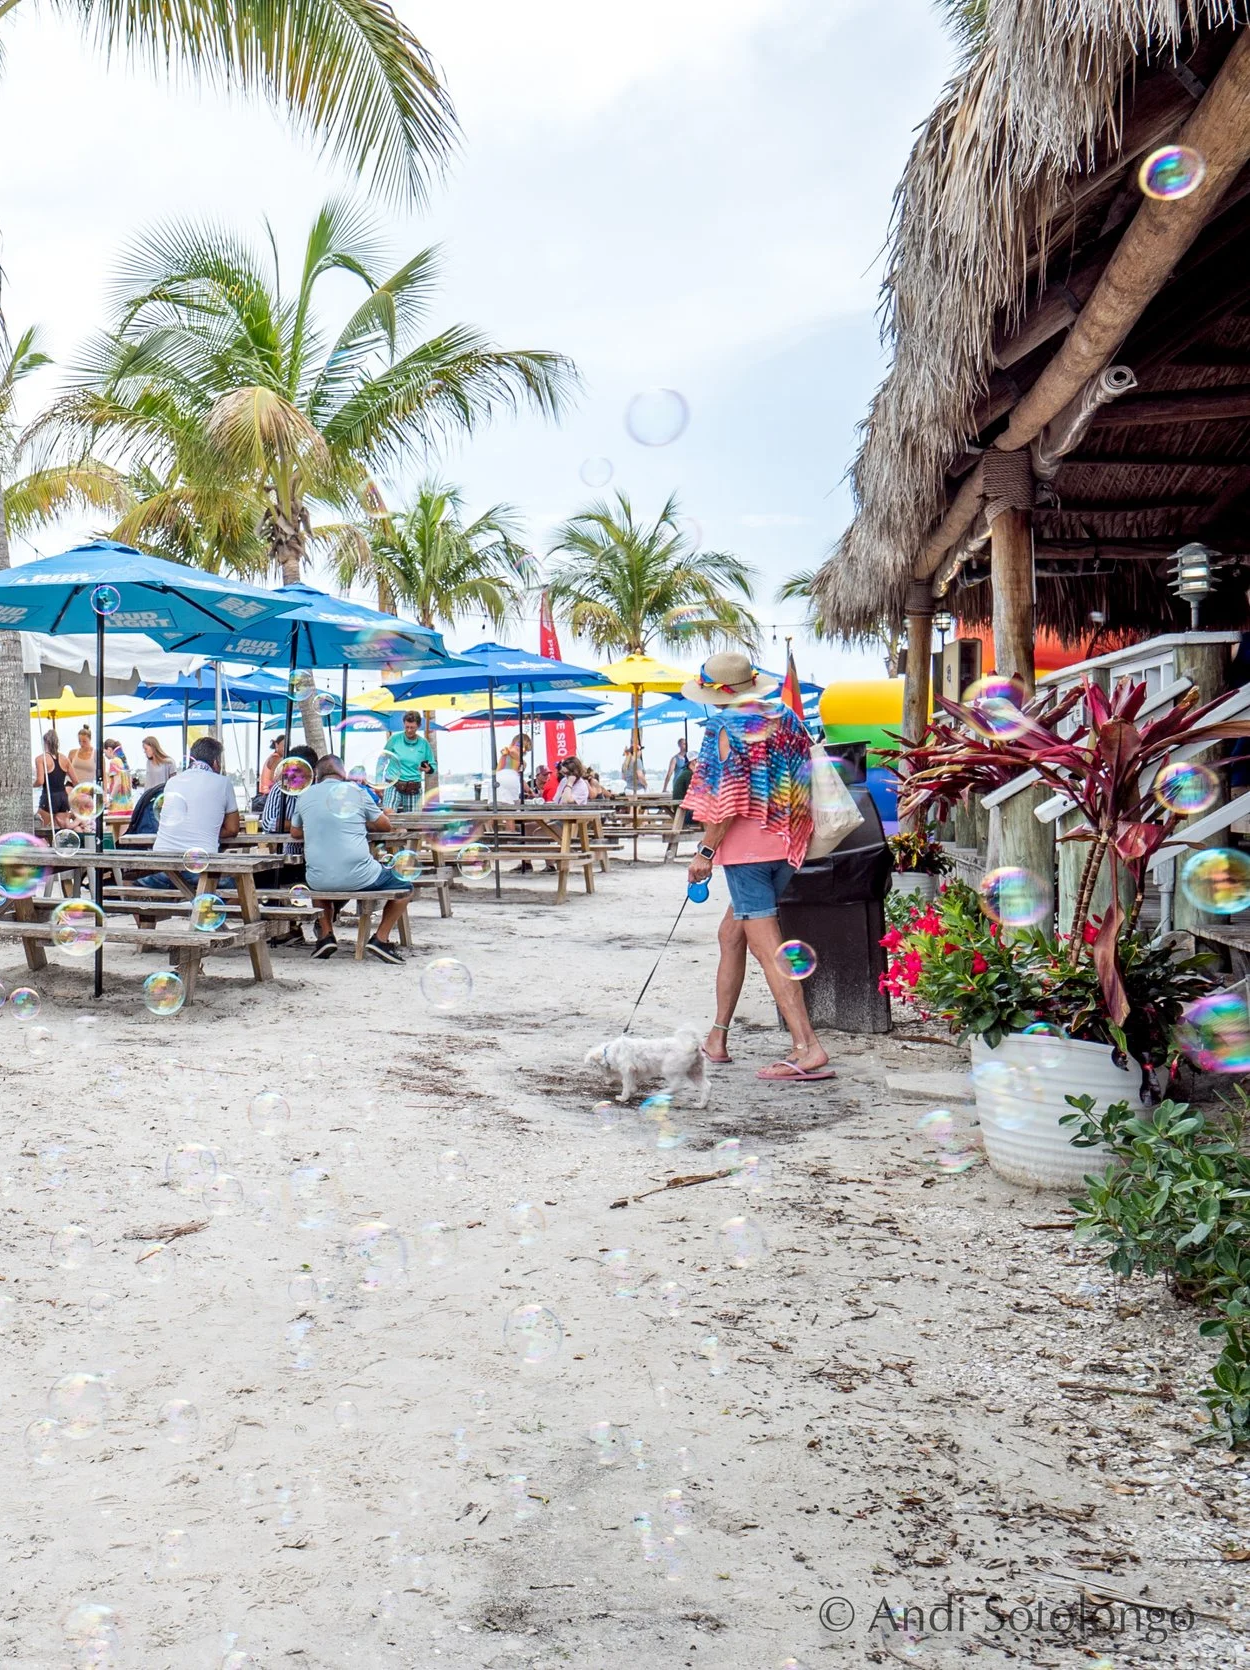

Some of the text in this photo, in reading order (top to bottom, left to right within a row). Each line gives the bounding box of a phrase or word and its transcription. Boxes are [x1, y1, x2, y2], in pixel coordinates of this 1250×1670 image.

[108, 611, 159, 621] BUD
[103, 618, 171, 628] LIGHT
[237, 638, 278, 649] BUD
[224, 644, 282, 657] LIGHT
[556, 732, 568, 756] SRQ
